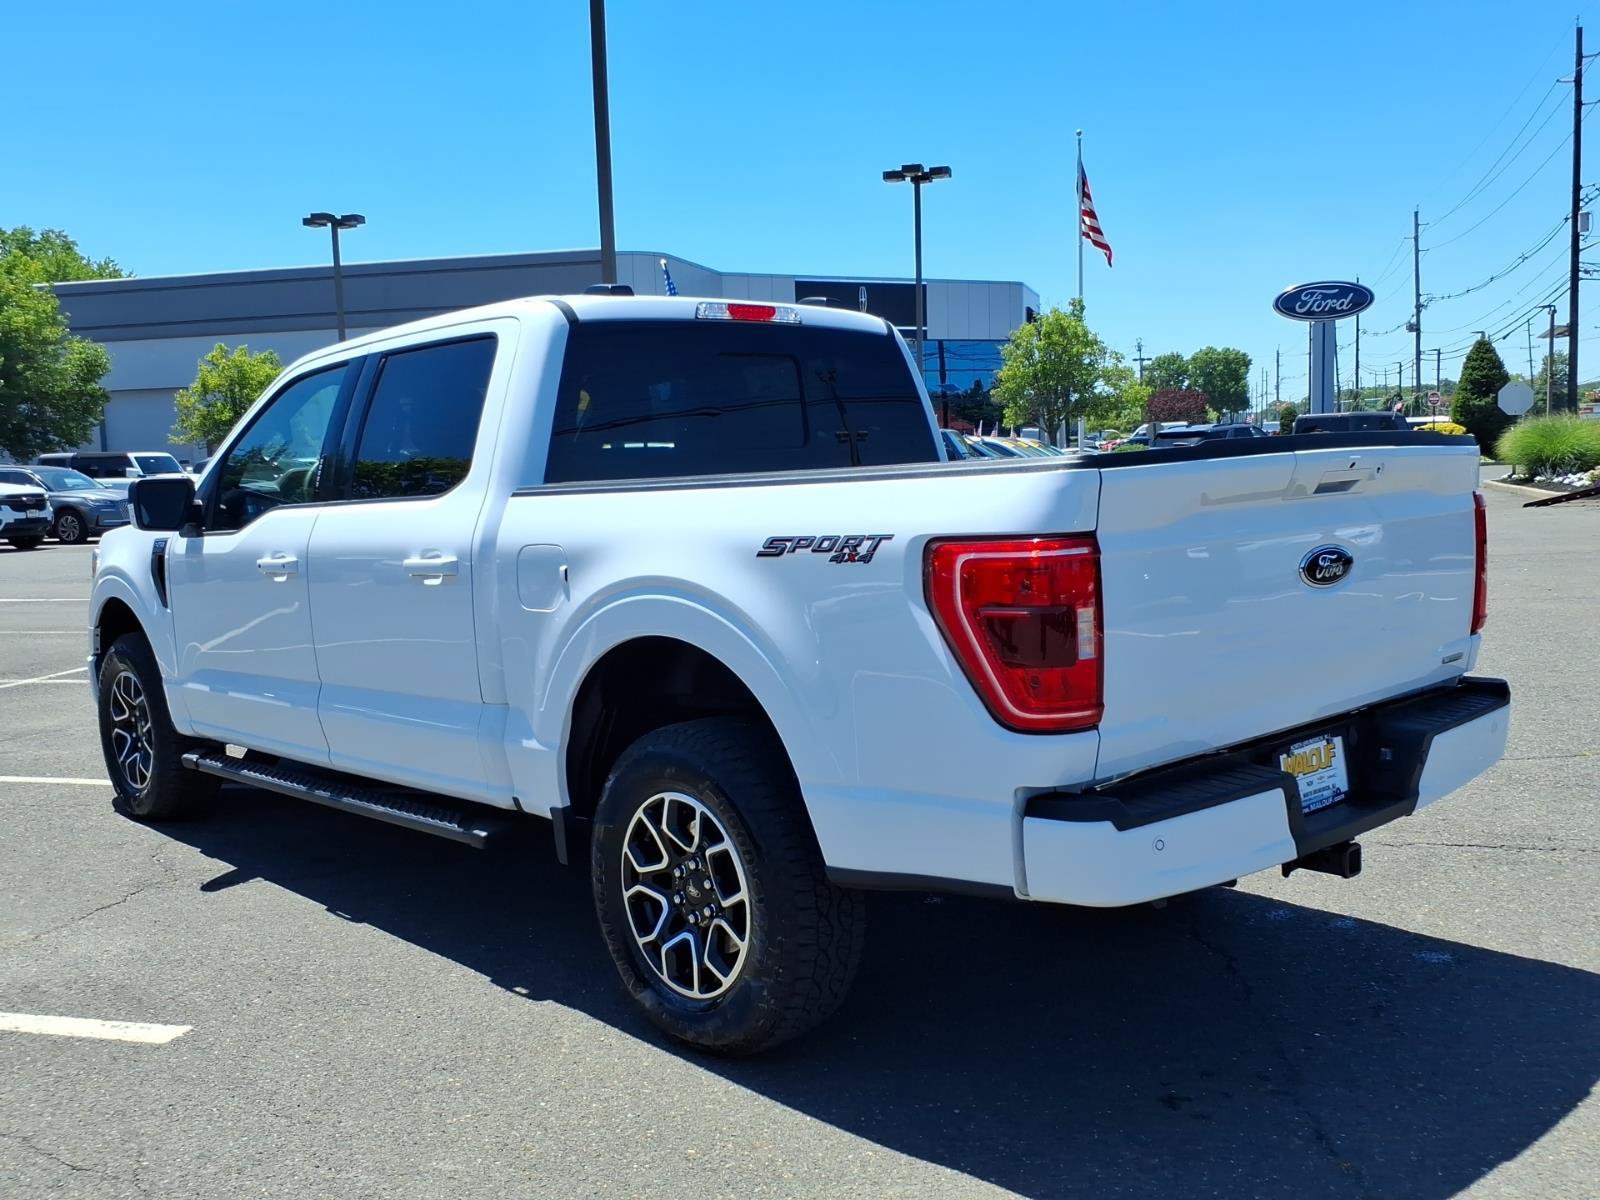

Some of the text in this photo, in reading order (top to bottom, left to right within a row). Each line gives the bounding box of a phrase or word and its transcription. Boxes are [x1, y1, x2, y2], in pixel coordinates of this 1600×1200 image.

[1295, 288, 1354, 313] Ford
[756, 533, 895, 558] SPORT
[1315, 554, 1345, 579] Ford
[1282, 743, 1337, 777] MALOUF
